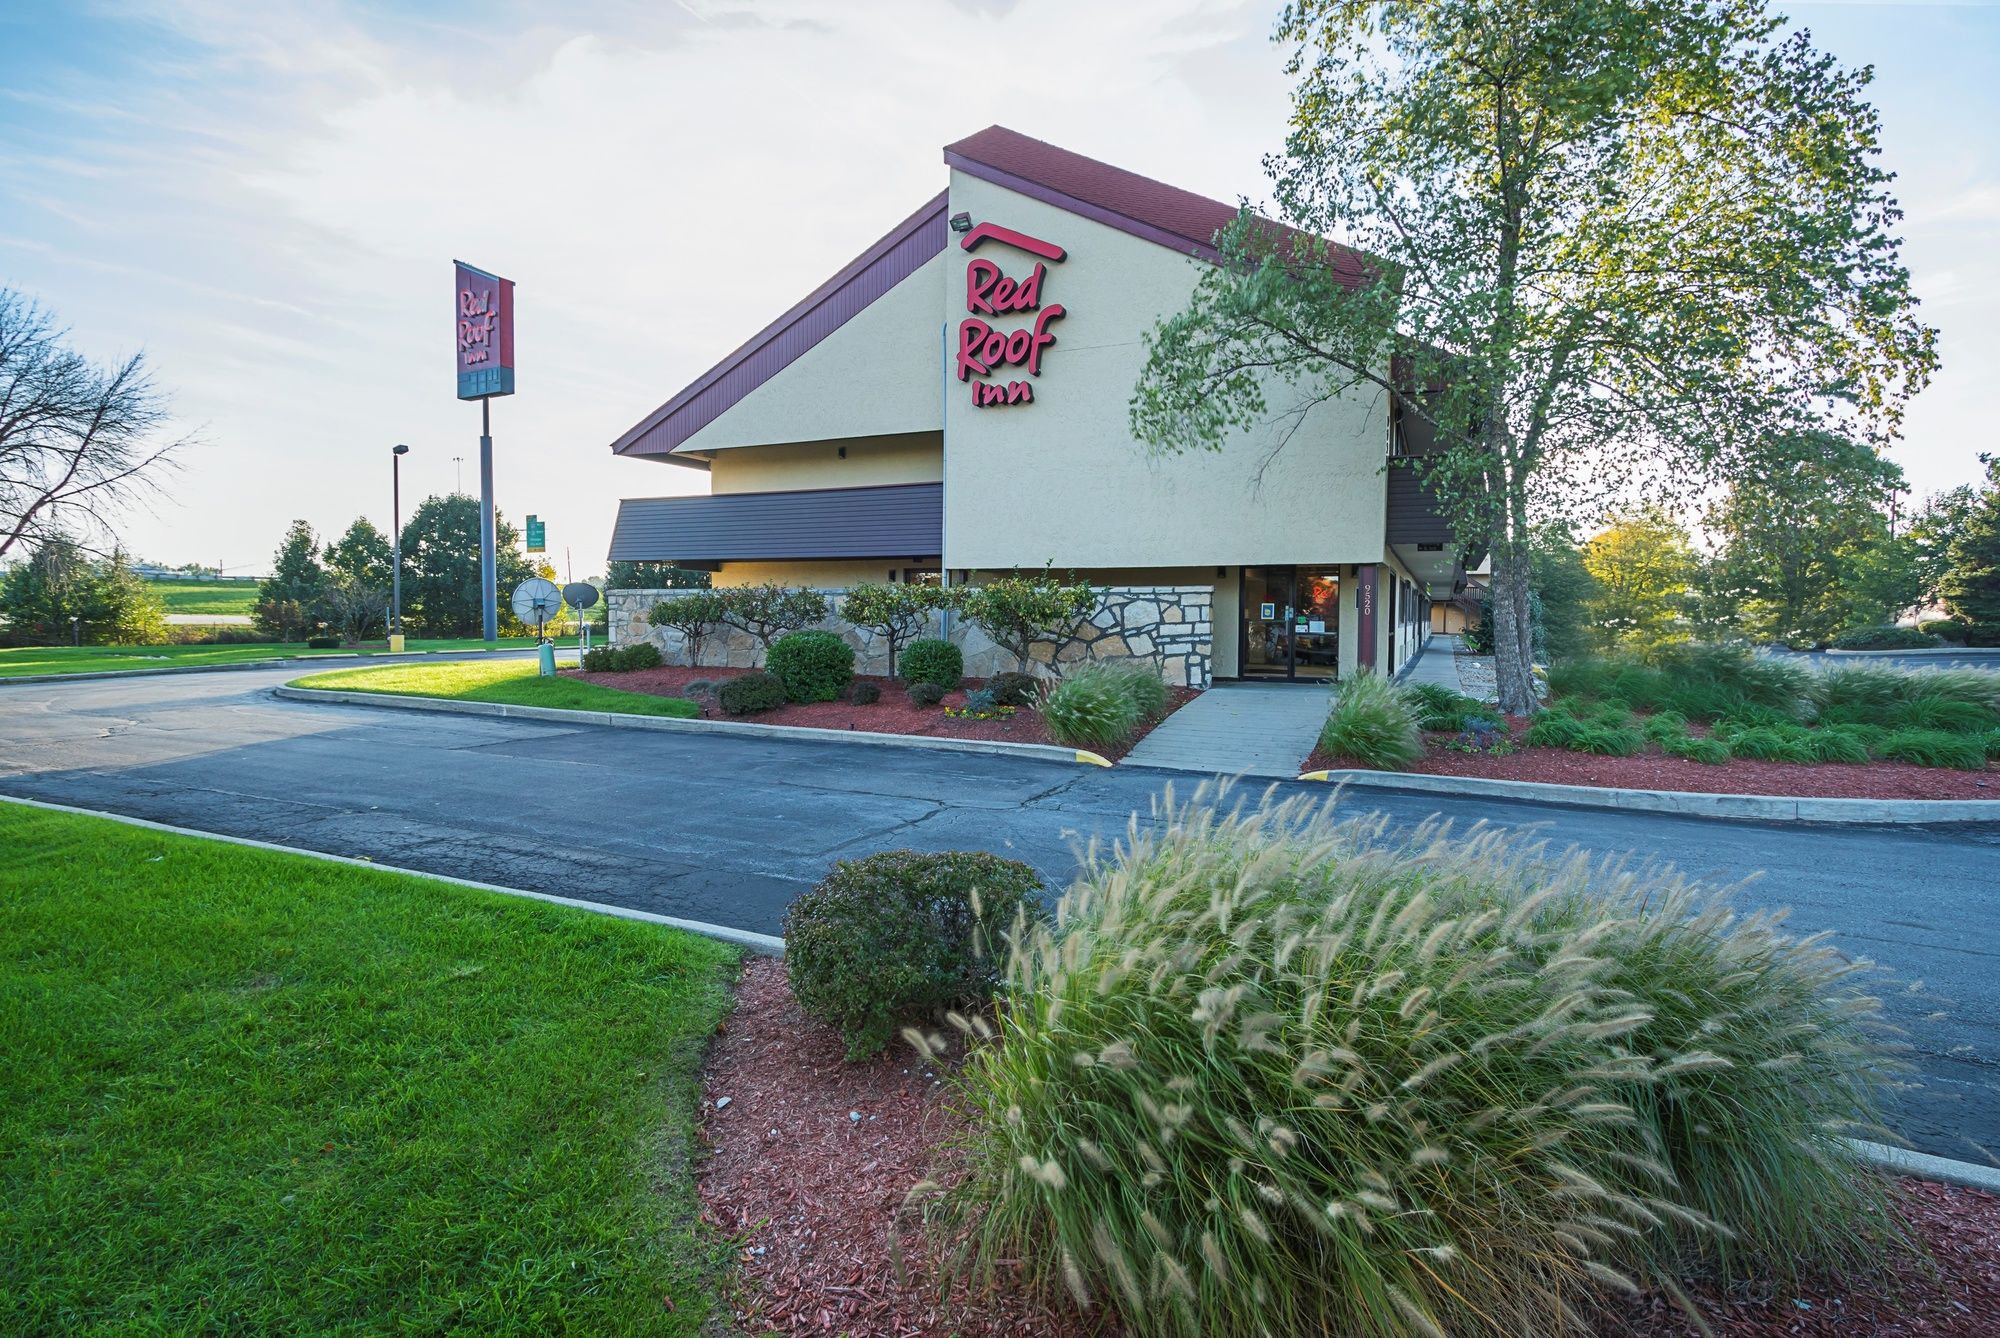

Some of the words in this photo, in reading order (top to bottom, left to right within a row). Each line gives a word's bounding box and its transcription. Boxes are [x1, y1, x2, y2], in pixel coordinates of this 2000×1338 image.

[460, 288, 490, 318] Red
[967, 258, 1046, 317] Red
[459, 310, 497, 352] Roof
[957, 303, 1067, 382] Roof
